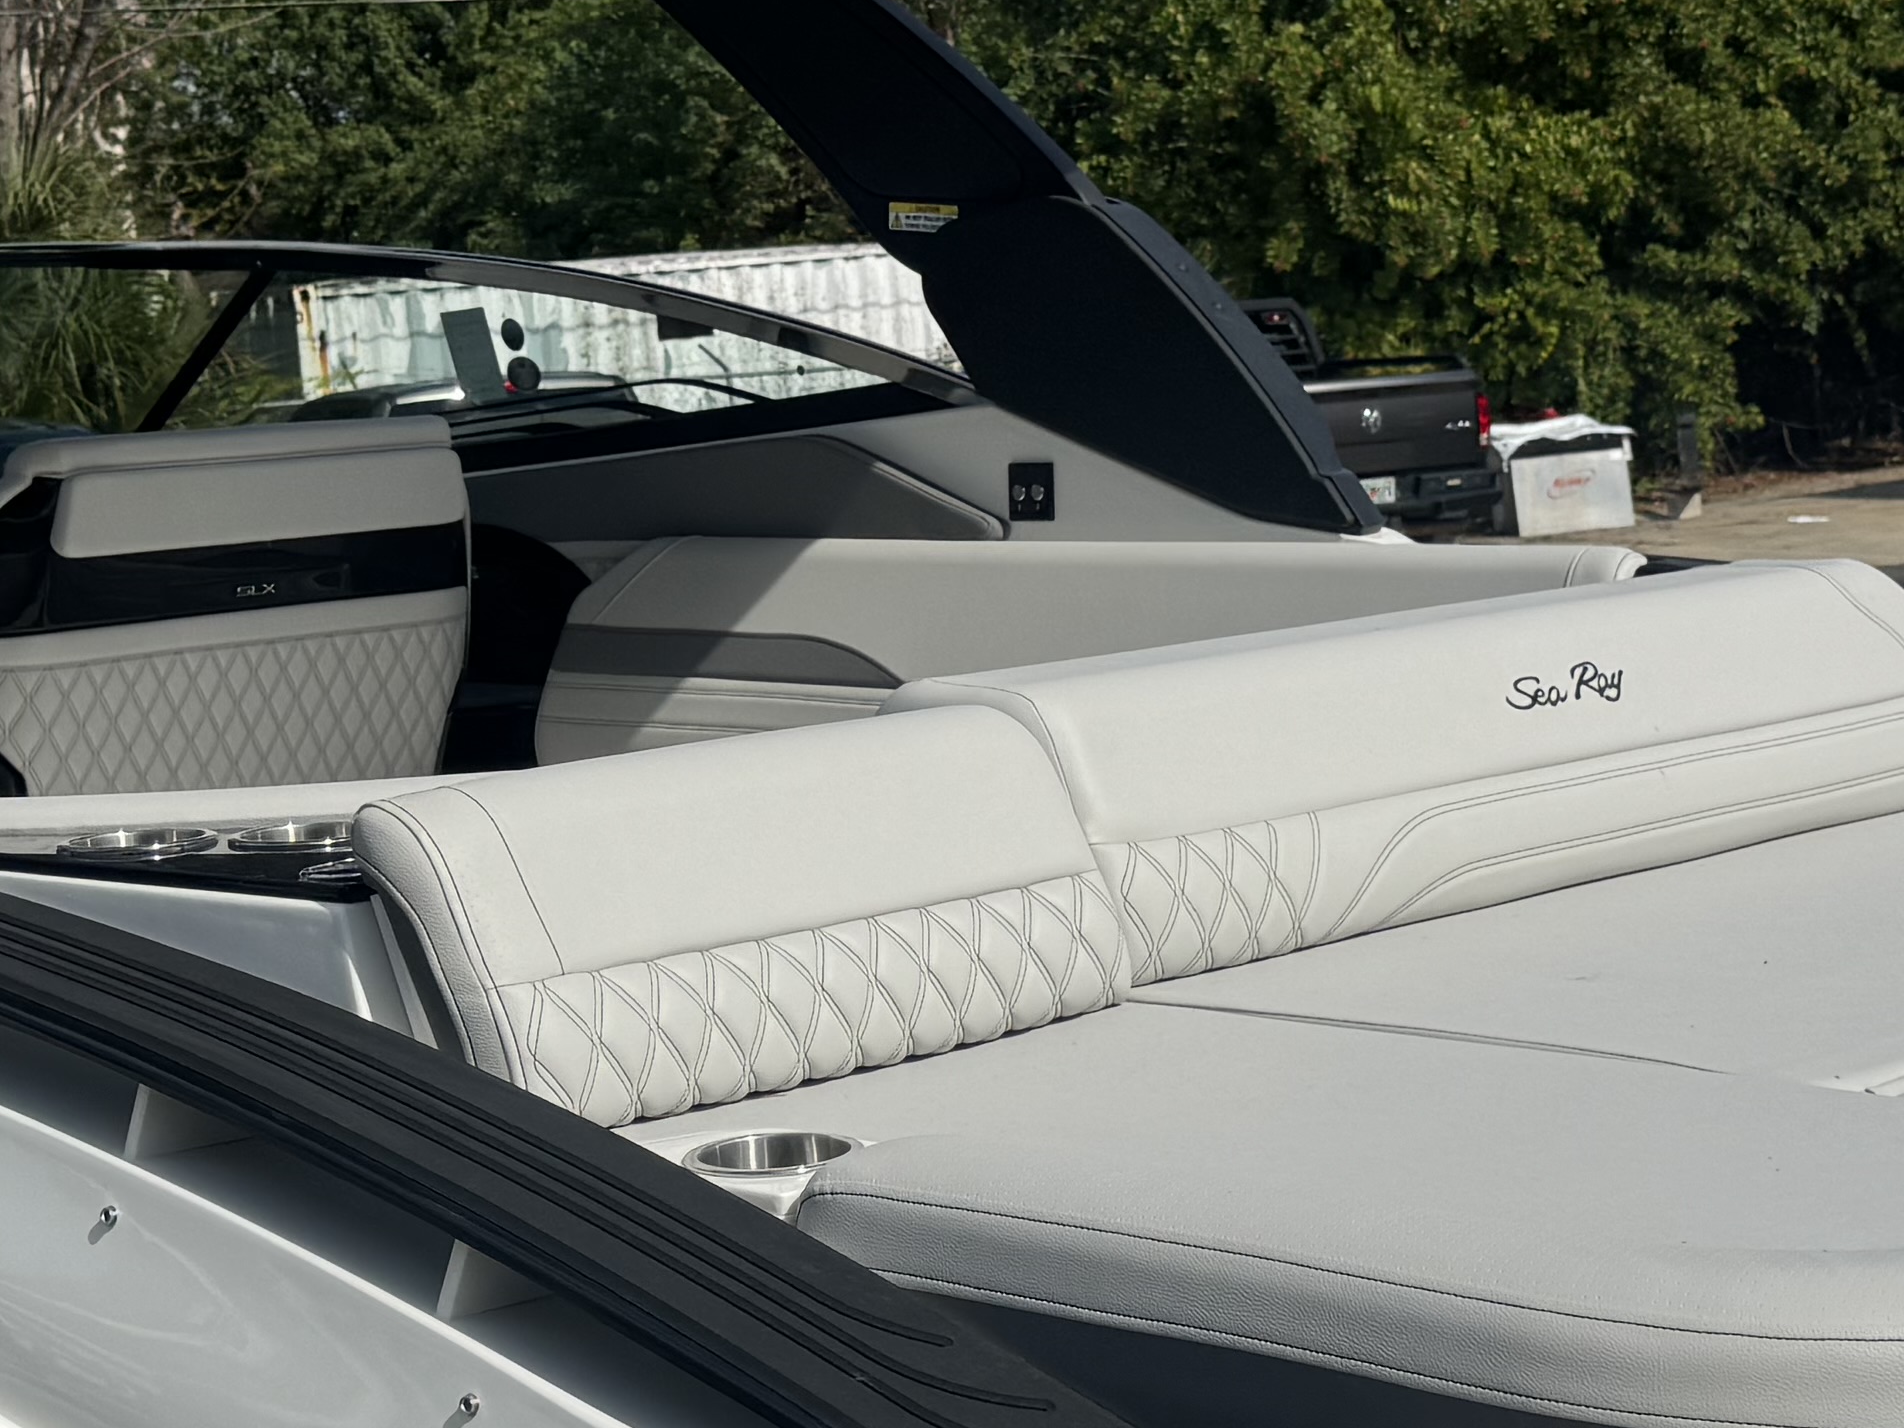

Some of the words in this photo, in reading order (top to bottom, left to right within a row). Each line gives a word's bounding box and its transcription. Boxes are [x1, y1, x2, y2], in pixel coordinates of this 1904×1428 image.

[236, 583, 276, 598] SLX
[1505, 675, 1569, 711] Sea
[1569, 660, 1624, 703] Ray
